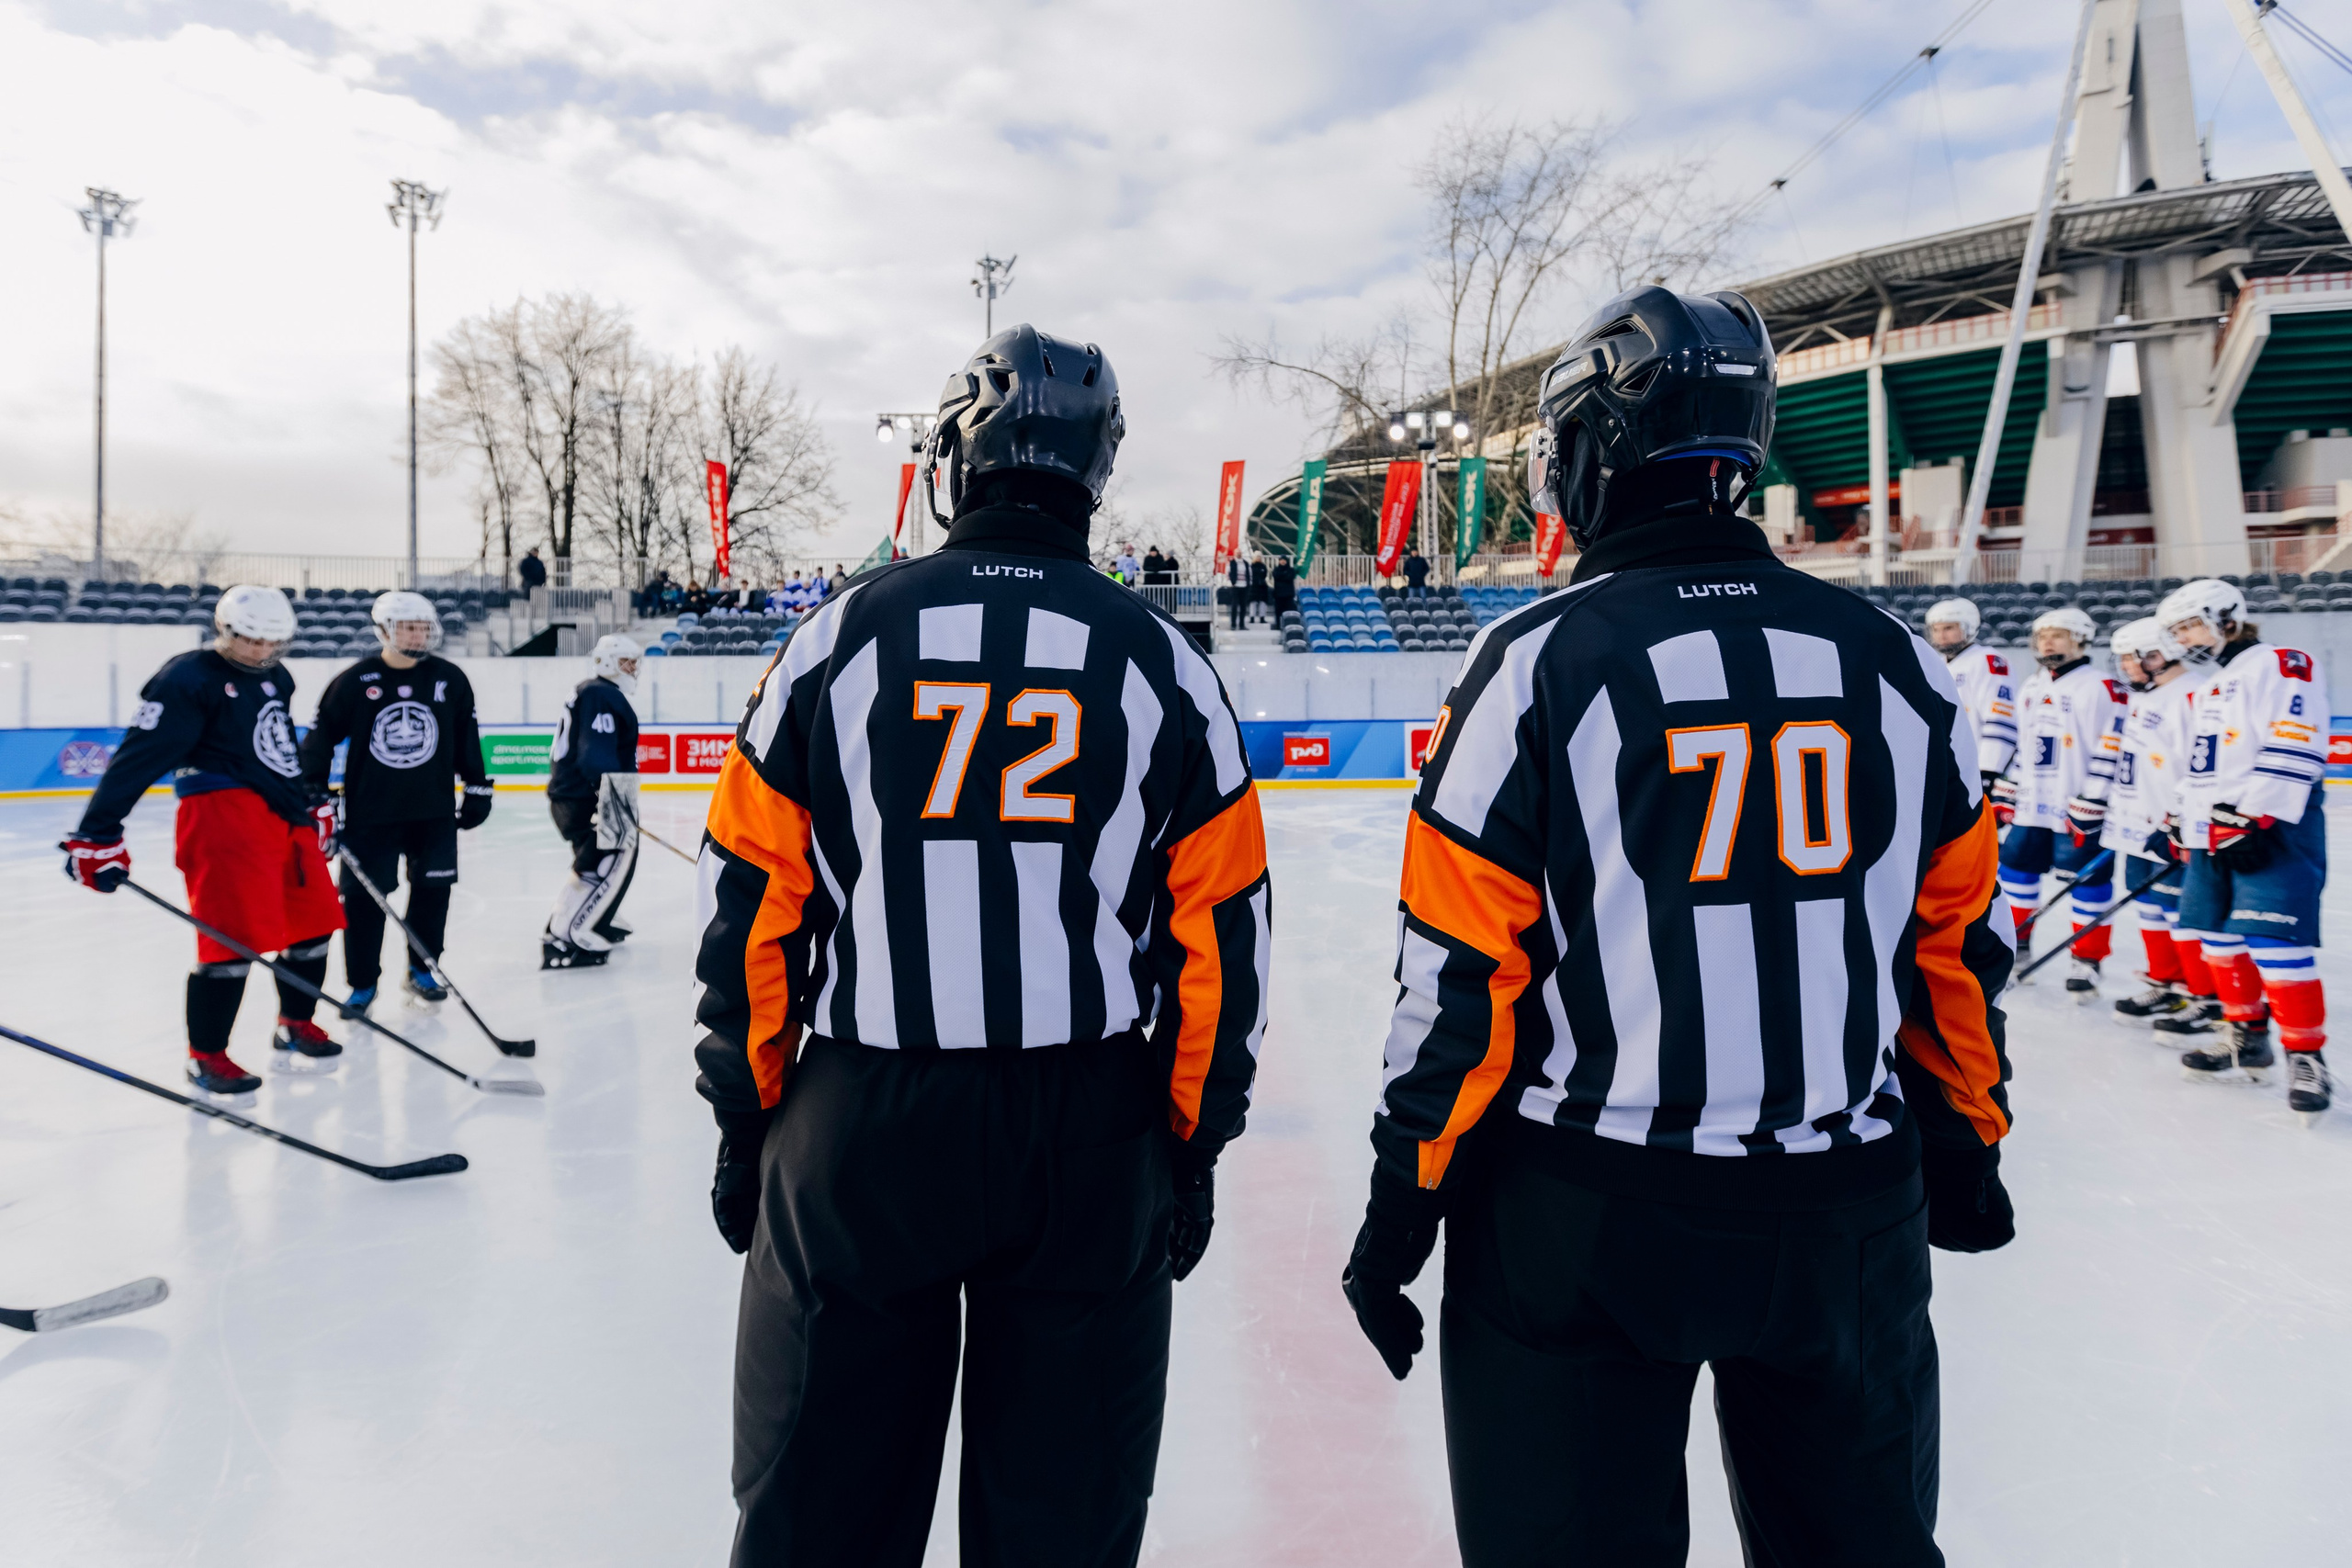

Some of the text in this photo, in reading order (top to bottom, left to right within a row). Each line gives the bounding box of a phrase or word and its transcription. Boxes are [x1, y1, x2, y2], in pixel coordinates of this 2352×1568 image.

[972, 565, 1044, 580] LUTCH
[1678, 582, 1758, 598] LUTCH
[2289, 694, 2302, 716] 8
[591, 712, 616, 734] 40
[913, 681, 1082, 823] 72
[1665, 720, 1853, 883] 70
